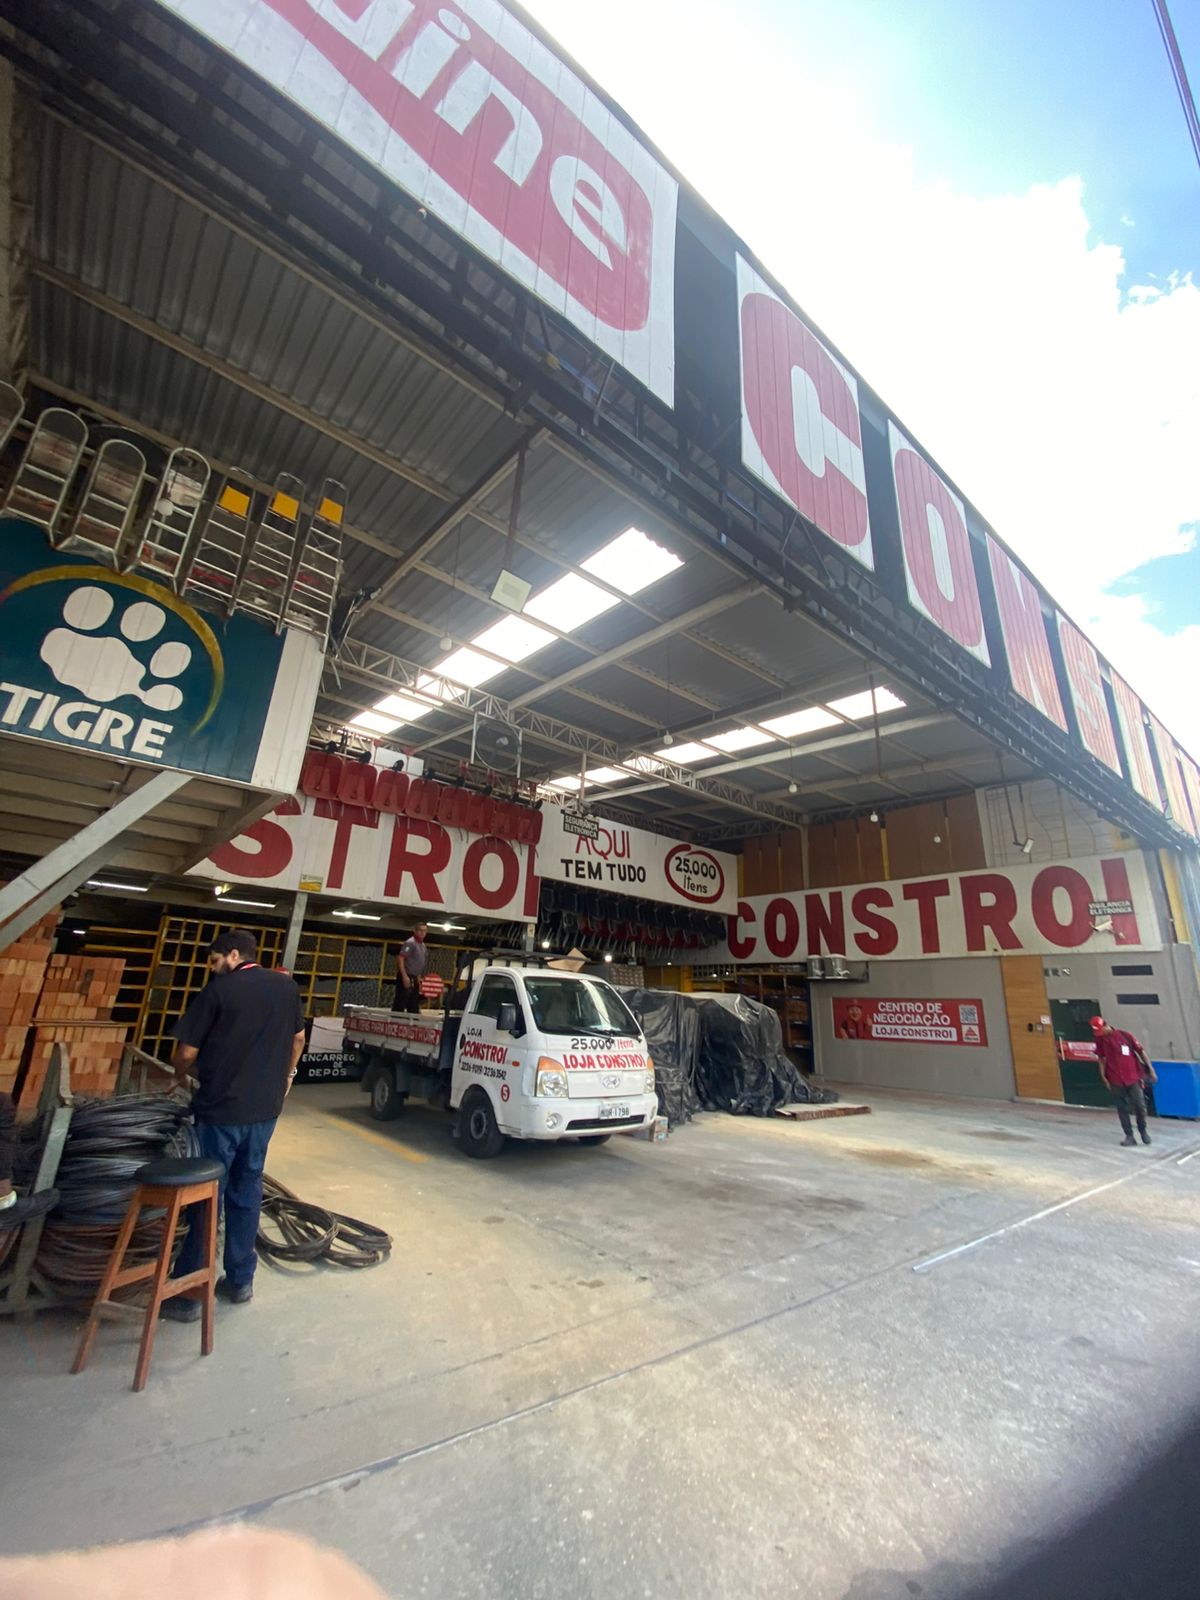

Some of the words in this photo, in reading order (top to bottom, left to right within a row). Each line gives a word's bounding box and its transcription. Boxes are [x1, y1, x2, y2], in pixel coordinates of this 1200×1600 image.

[0, 682, 174, 759] TIGRE
[575, 827, 631, 860] AQUI
[561, 859, 602, 880] TEM
[606, 864, 646, 882] TUDO
[675, 856, 717, 880] 25.000
[728, 858, 1141, 959] CONSTROI
[878, 1002, 924, 1013] CENTRO
[927, 1003, 943, 1014] DE
[873, 1013, 950, 1026] NEGOCIAÇÃO
[467, 1027, 482, 1037] LOJA
[875, 1027, 899, 1036] LOJA
[901, 1028, 953, 1039] CONSTROI
[463, 1040, 508, 1065] CONSTROI
[570, 1038, 614, 1050] 25.000
[563, 1054, 596, 1069] LOJA
[597, 1054, 647, 1069] CONSTROI
